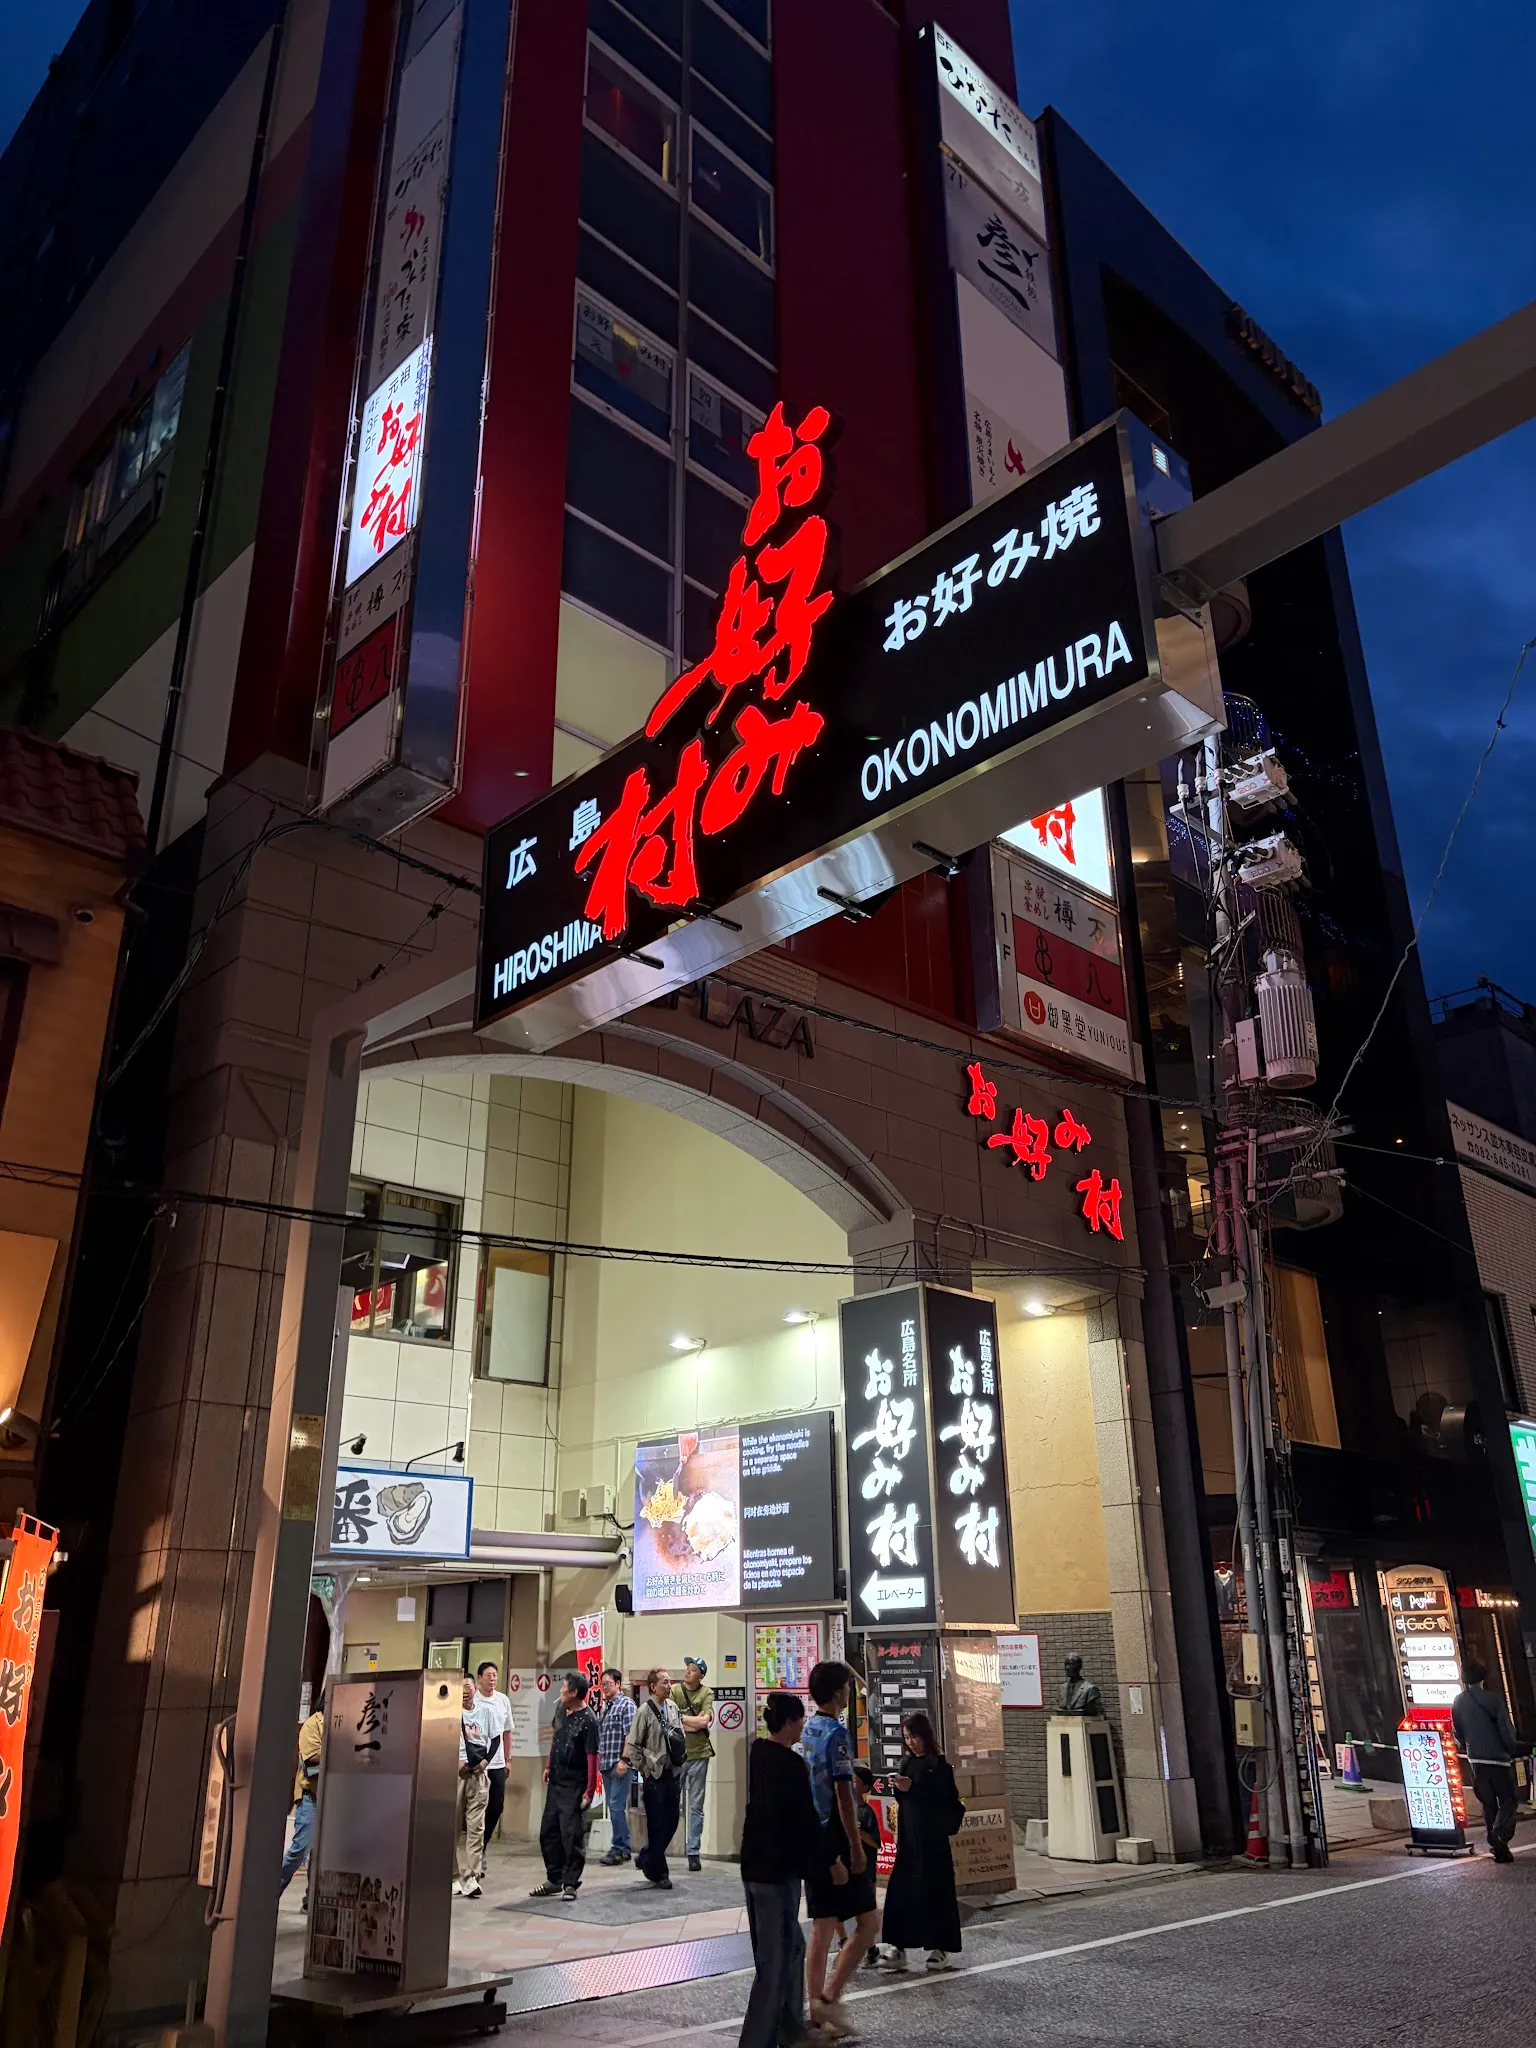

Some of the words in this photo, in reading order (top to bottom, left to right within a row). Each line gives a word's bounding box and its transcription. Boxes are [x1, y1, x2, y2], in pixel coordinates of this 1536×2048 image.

[937, 32, 953, 53] 5F
[940, 57, 1012, 144] ひなた
[388, 363, 412, 400] 元祖
[360, 399, 422, 555] お好み村
[883, 481, 1102, 652] お好み焼
[576, 400, 835, 943] お好み村
[861, 620, 1134, 802] OKONOMIMURA
[506, 797, 602, 889] 広島
[493, 919, 603, 1000] HIROSHIMA
[1087, 1025, 1127, 1055] YUNIQUE
[968, 1062, 1125, 1241] お好み村
[900, 1319, 917, 1387] 広島名所
[978, 1329, 995, 1396] 広島名所
[742, 1437, 757, 1447] While
[758, 1434, 768, 1445] the
[769, 1429, 804, 1443] okonomiyaki
[804, 1428, 811, 1437] is
[765, 1444, 775, 1454] fry
[775, 1442, 785, 1452] the
[786, 1439, 809, 1450] noodles
[742, 1458, 748, 1466] in
[754, 1454, 779, 1464] separate
[780, 1453, 797, 1463] space
[851, 1347, 920, 1567] お好み村
[939, 1344, 1000, 1568] お好み村
[751, 1466, 761, 1475] the
[743, 1548, 767, 1559] Mientras
[767, 1547, 787, 1556] hornea
[788, 1545, 794, 1555] el
[779, 1556, 802, 1568] prepare
[803, 1555, 813, 1565] los
[743, 1570, 760, 1579] fideos
[761, 1570, 769, 1578] en
[769, 1569, 781, 1578] otro
[782, 1566, 805, 1579] espacio
[743, 1581, 751, 1590] de
[752, 1580, 757, 1589] la
[877, 1586, 922, 1602] エレベーター
[1392, 1597, 1400, 1607] 6
[1395, 1618, 1404, 1630] 5
[1403, 1665, 1410, 1677] 3
[1407, 1689, 1413, 1698] 2
[960, 1813, 1002, 1829] 天地PLAZA
